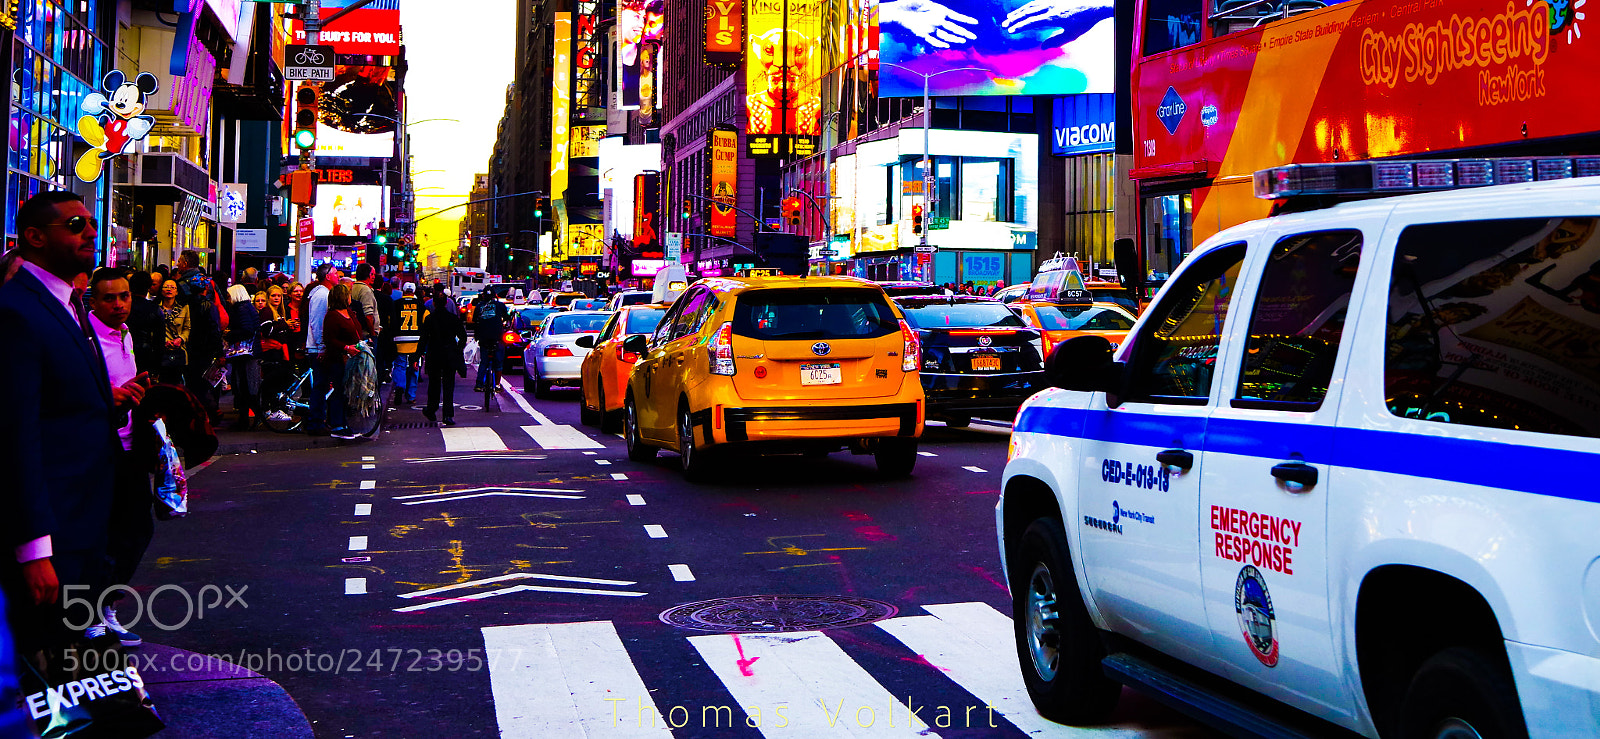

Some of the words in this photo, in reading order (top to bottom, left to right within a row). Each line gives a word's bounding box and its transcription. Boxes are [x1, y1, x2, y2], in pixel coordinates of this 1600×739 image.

[751, 1, 781, 15] KING
[716, 0, 735, 45] VI'S
[320, 31, 351, 42] BUD'S
[352, 31, 371, 43] FOR
[373, 32, 396, 43] YOU.
[1169, 61, 1187, 74] Statue
[1221, 49, 1239, 62] Times
[1240, 43, 1262, 58] Square
[1269, 33, 1293, 50] Empire
[1295, 28, 1313, 43] State
[1315, 20, 1345, 38] Building
[1350, 12, 1379, 28] Harlem
[1390, 2, 1421, 19] Central
[1424, 0, 1444, 13] Park
[290, 69, 307, 77] BIKE
[312, 69, 330, 77] PATH
[714, 135, 736, 149] BUBBA
[715, 149, 735, 162] GUMP
[966, 257, 1000, 271] 1515
[750, 269, 770, 277] 6C25
[400, 310, 418, 330] 71
[1210, 504, 1302, 548] EMERGENCY
[1215, 532, 1294, 575] RESPONSE
[26, 666, 145, 720] EXPRESS
